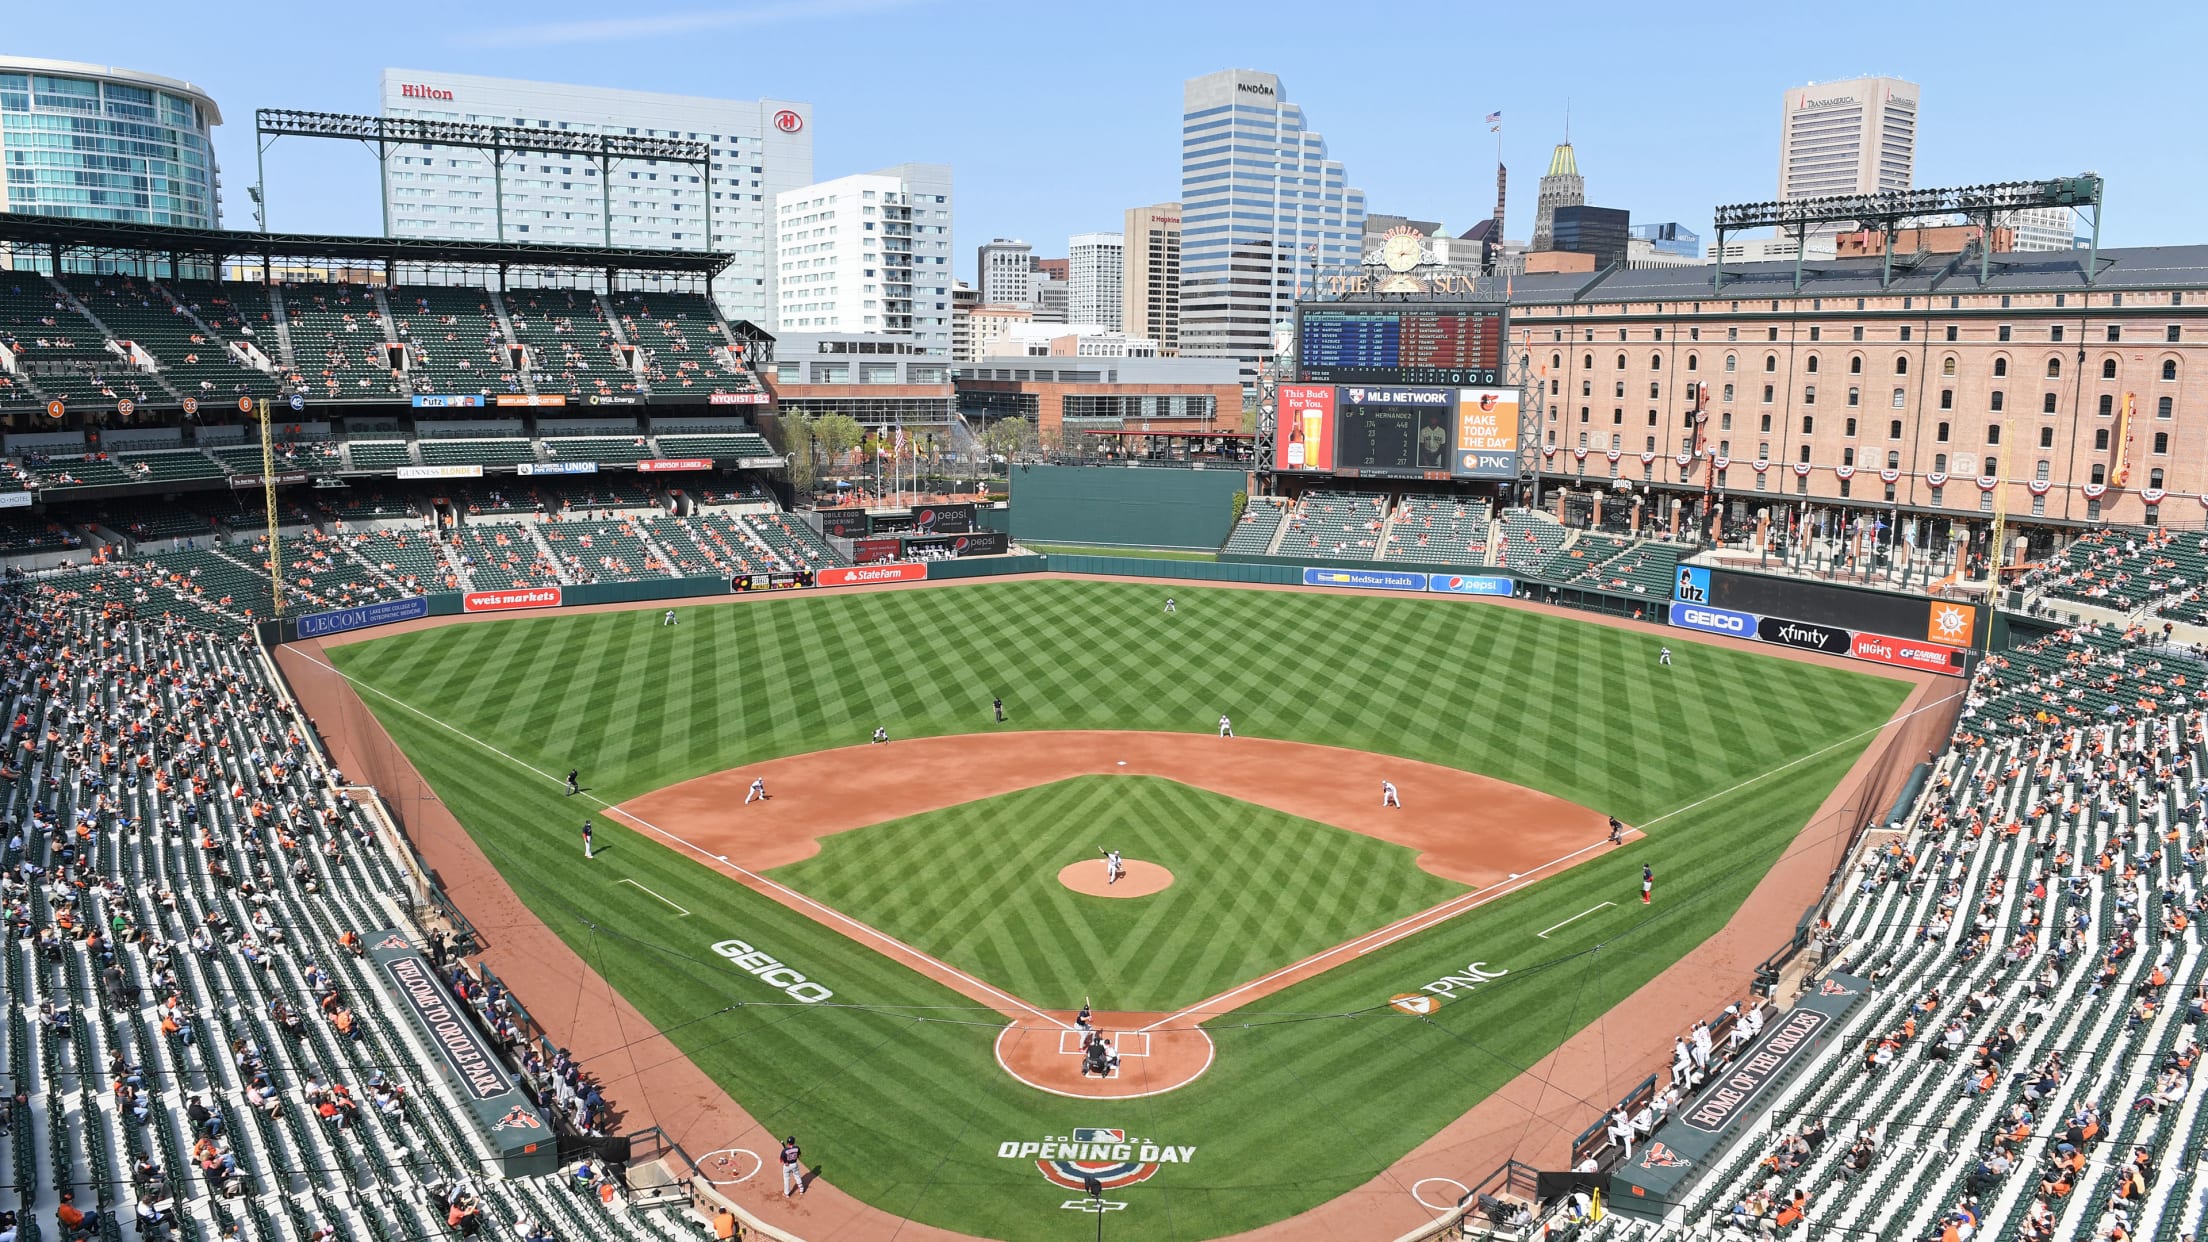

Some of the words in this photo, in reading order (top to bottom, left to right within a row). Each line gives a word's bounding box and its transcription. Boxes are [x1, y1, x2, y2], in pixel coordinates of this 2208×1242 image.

[402, 84, 453, 100] Hilton
[1383, 225, 1424, 241] ORIOLES
[1328, 275, 1369, 292] THE
[1433, 275, 1476, 293] SUN
[1453, 374, 1459, 382] 0
[1469, 374, 1476, 382] 0
[1486, 374, 1493, 383] 0
[1284, 390, 1304, 398] This
[1306, 390, 1328, 398] Bud's
[1368, 392, 1390, 401] MLB
[1393, 393, 1447, 403] NETWORK
[53, 405, 59, 414] 4
[121, 403, 131, 411] 22
[186, 401, 196, 410] 33
[1289, 400, 1303, 408] For
[1306, 400, 1323, 408] You.
[1360, 407, 1364, 416] 5
[1464, 416, 1496, 425] MAKE
[1464, 427, 1498, 436] TODAY
[1463, 438, 1483, 447] THE
[565, 462, 595, 472] UNION
[1480, 457, 1509, 468] PNC
[399, 468, 440, 477] GUINNESS
[441, 467, 470, 475] BLONDE
[938, 509, 967, 522] pepsi
[970, 536, 995, 546] pepsi
[1351, 576, 1383, 585] MedStar
[1385, 577, 1412, 586] Health
[1465, 580, 1496, 592] pepsi
[472, 594, 501, 606] weis
[503, 592, 555, 603] markets
[305, 611, 367, 632] LECOM
[1684, 609, 1743, 631] GEICO
[1778, 623, 1829, 647] xfinity
[1858, 642, 1892, 659] HIGH'S
[1914, 650, 1947, 661] CARROLL
[711, 939, 833, 1003] GEICO
[393, 960, 442, 1008] WELCOME
[1420, 962, 1508, 998] PNC
[424, 1004, 451, 1022] TO
[435, 1022, 480, 1064] ORIOLE
[1692, 1088, 1744, 1127] HOME
[1730, 1071, 1759, 1090] OF
[1747, 1052, 1782, 1076] THE
[1767, 1012, 1821, 1054] ORIOLES
[462, 1056, 505, 1096] PARK
[998, 1142, 1131, 1160] OPENING
[1139, 1144, 1197, 1163] DAY
